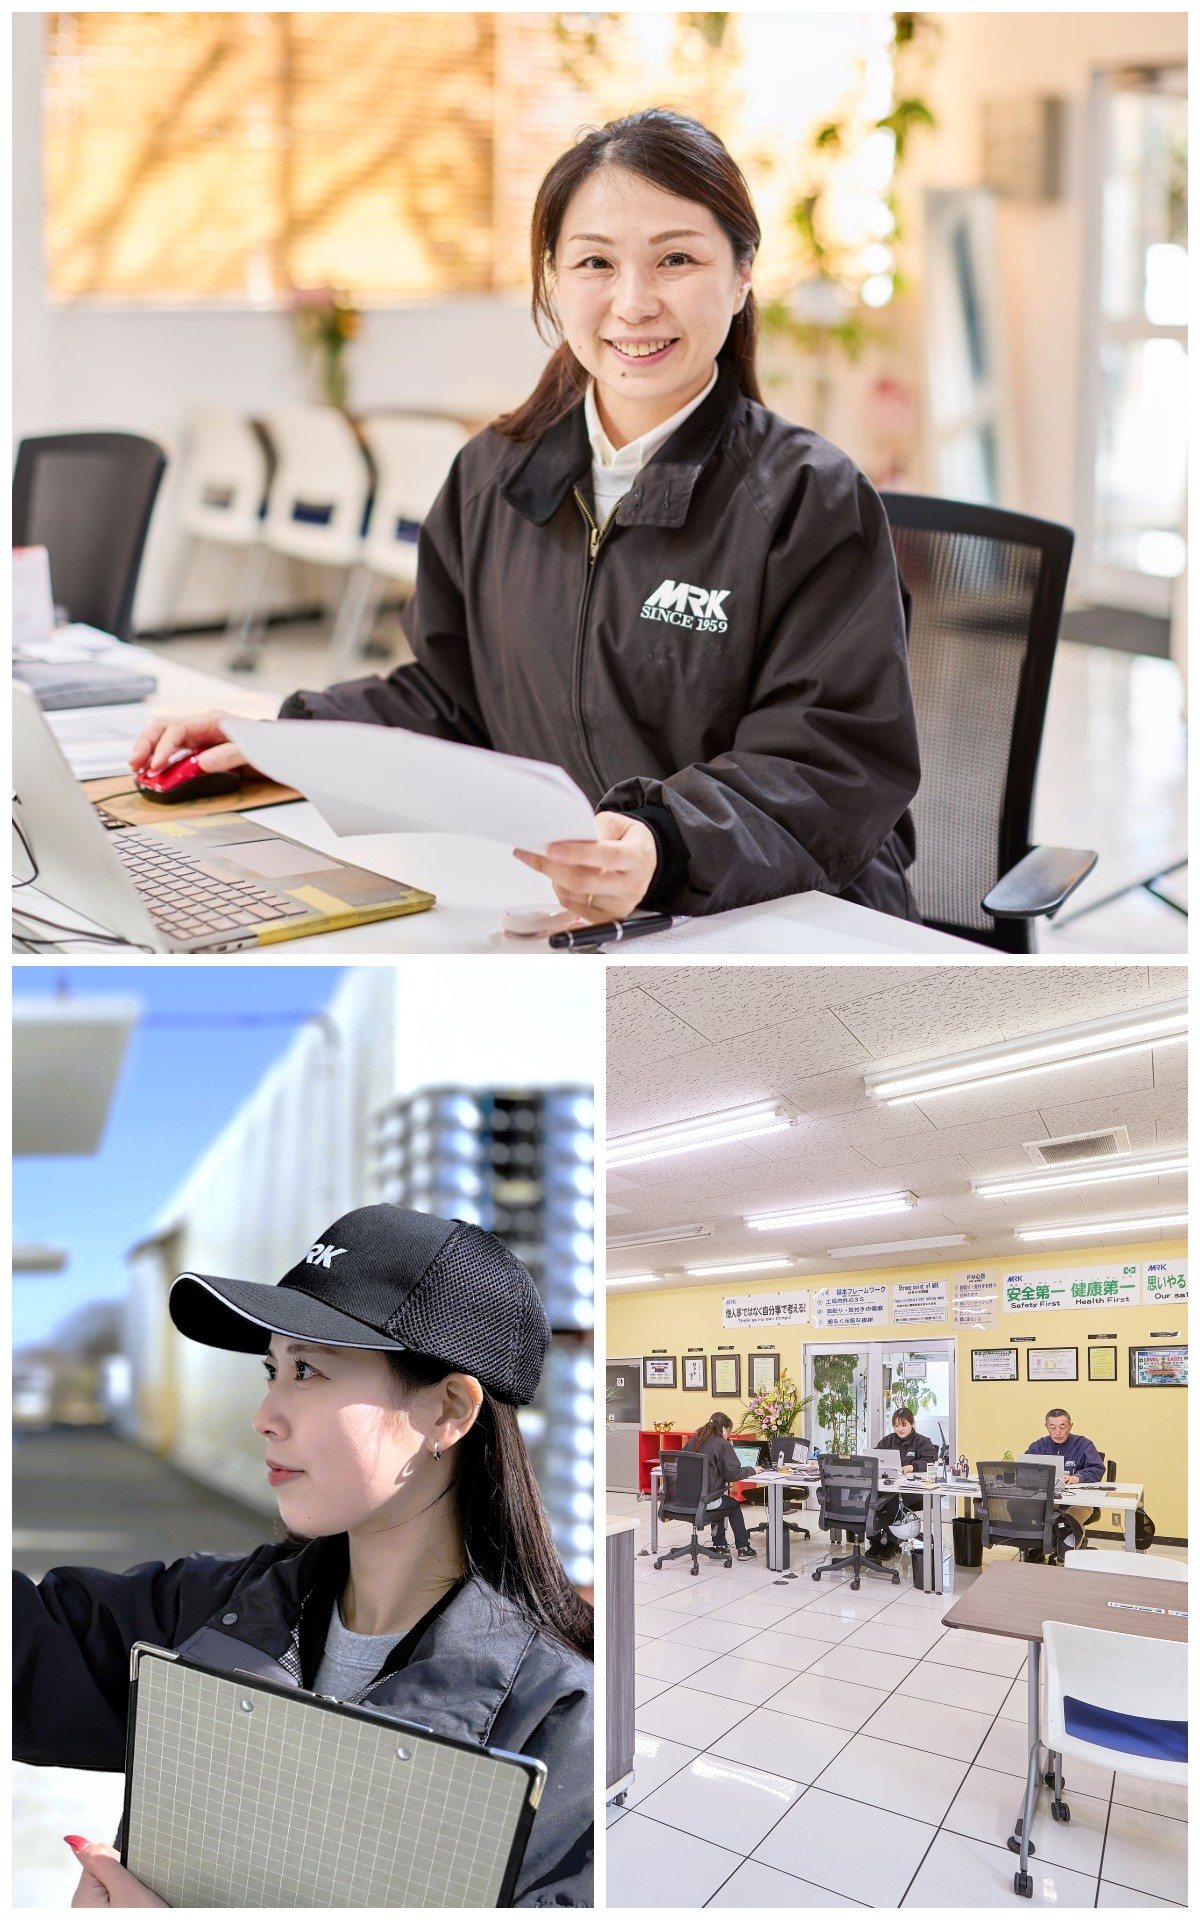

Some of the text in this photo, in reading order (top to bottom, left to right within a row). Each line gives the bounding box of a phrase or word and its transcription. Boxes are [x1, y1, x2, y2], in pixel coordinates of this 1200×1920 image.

[644, 579, 732, 621] MRK
[640, 605, 728, 633] SINCE 1959
[1147, 1263, 1167, 1271] MRK
[1147, 1274, 1186, 1291] 思いやる
[1007, 1280, 1135, 1302] 安全第一 健康第一
[1154, 1292, 1171, 1300] Our
[1011, 1301, 1038, 1309] Safety
[1075, 1297, 1105, 1305] Health
